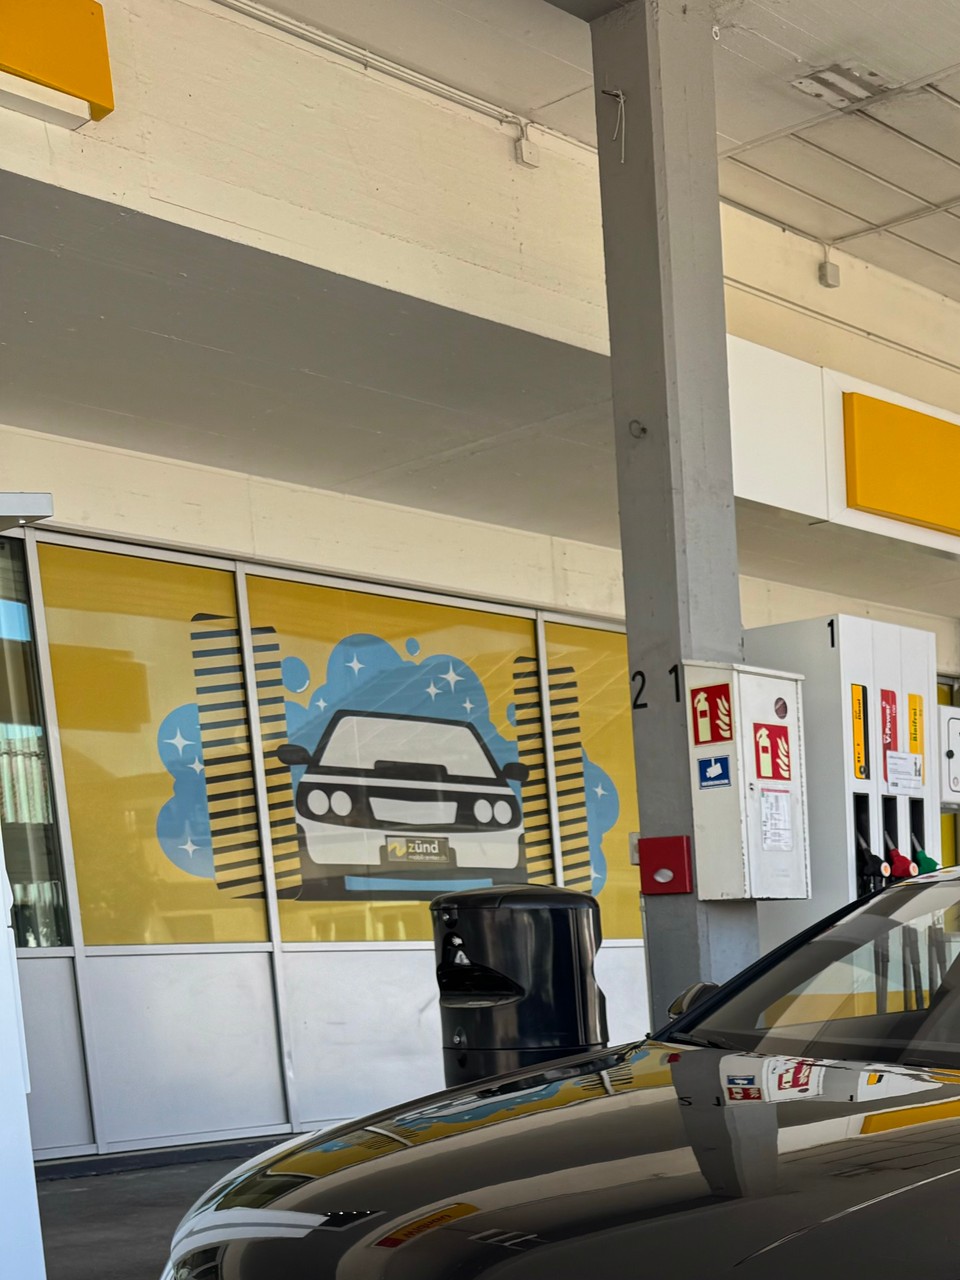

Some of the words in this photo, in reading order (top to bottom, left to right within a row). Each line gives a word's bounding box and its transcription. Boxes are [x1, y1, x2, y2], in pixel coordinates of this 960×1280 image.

[827, 618, 835, 648] 1
[631, 670, 648, 710] 2
[668, 663, 681, 703] 1
[884, 703, 892, 744] V-Power
[408, 840, 439, 853] zünd
